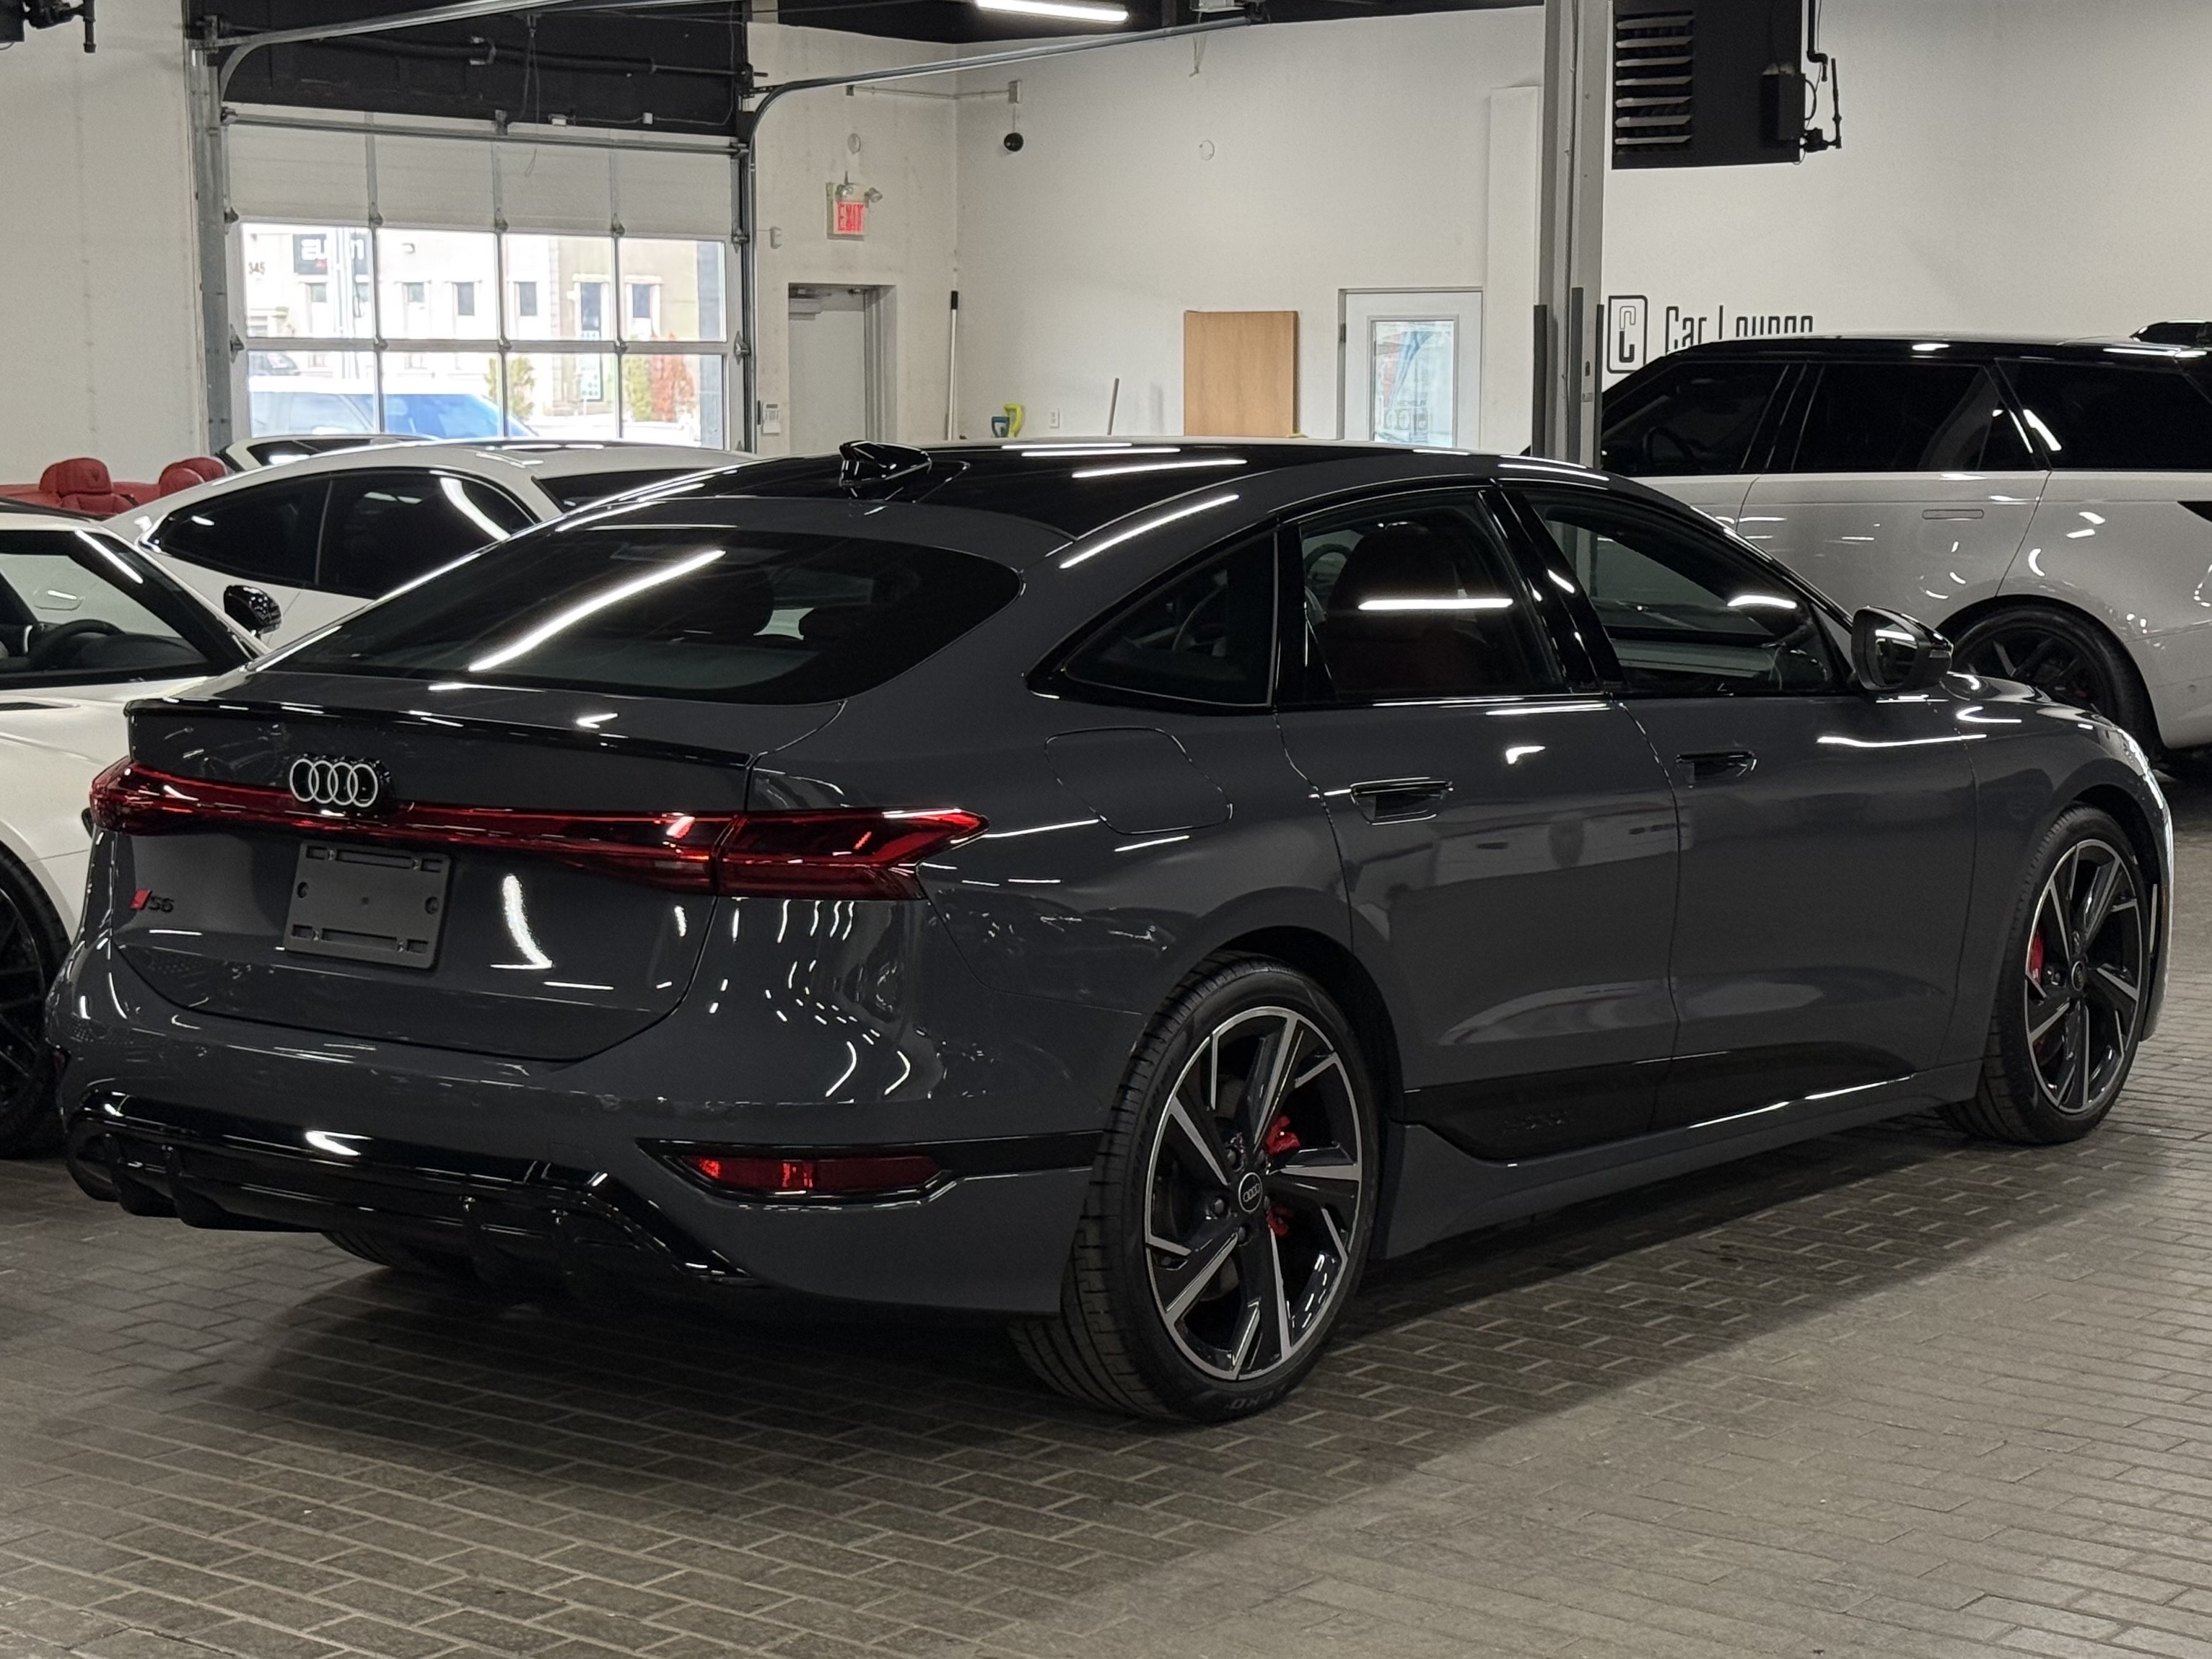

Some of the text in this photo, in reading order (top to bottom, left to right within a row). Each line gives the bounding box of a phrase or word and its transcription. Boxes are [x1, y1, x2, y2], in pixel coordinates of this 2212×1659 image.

[837, 203, 865, 231] EXIT
[1665, 306, 1708, 355] Car
[148, 895, 175, 913] S6
